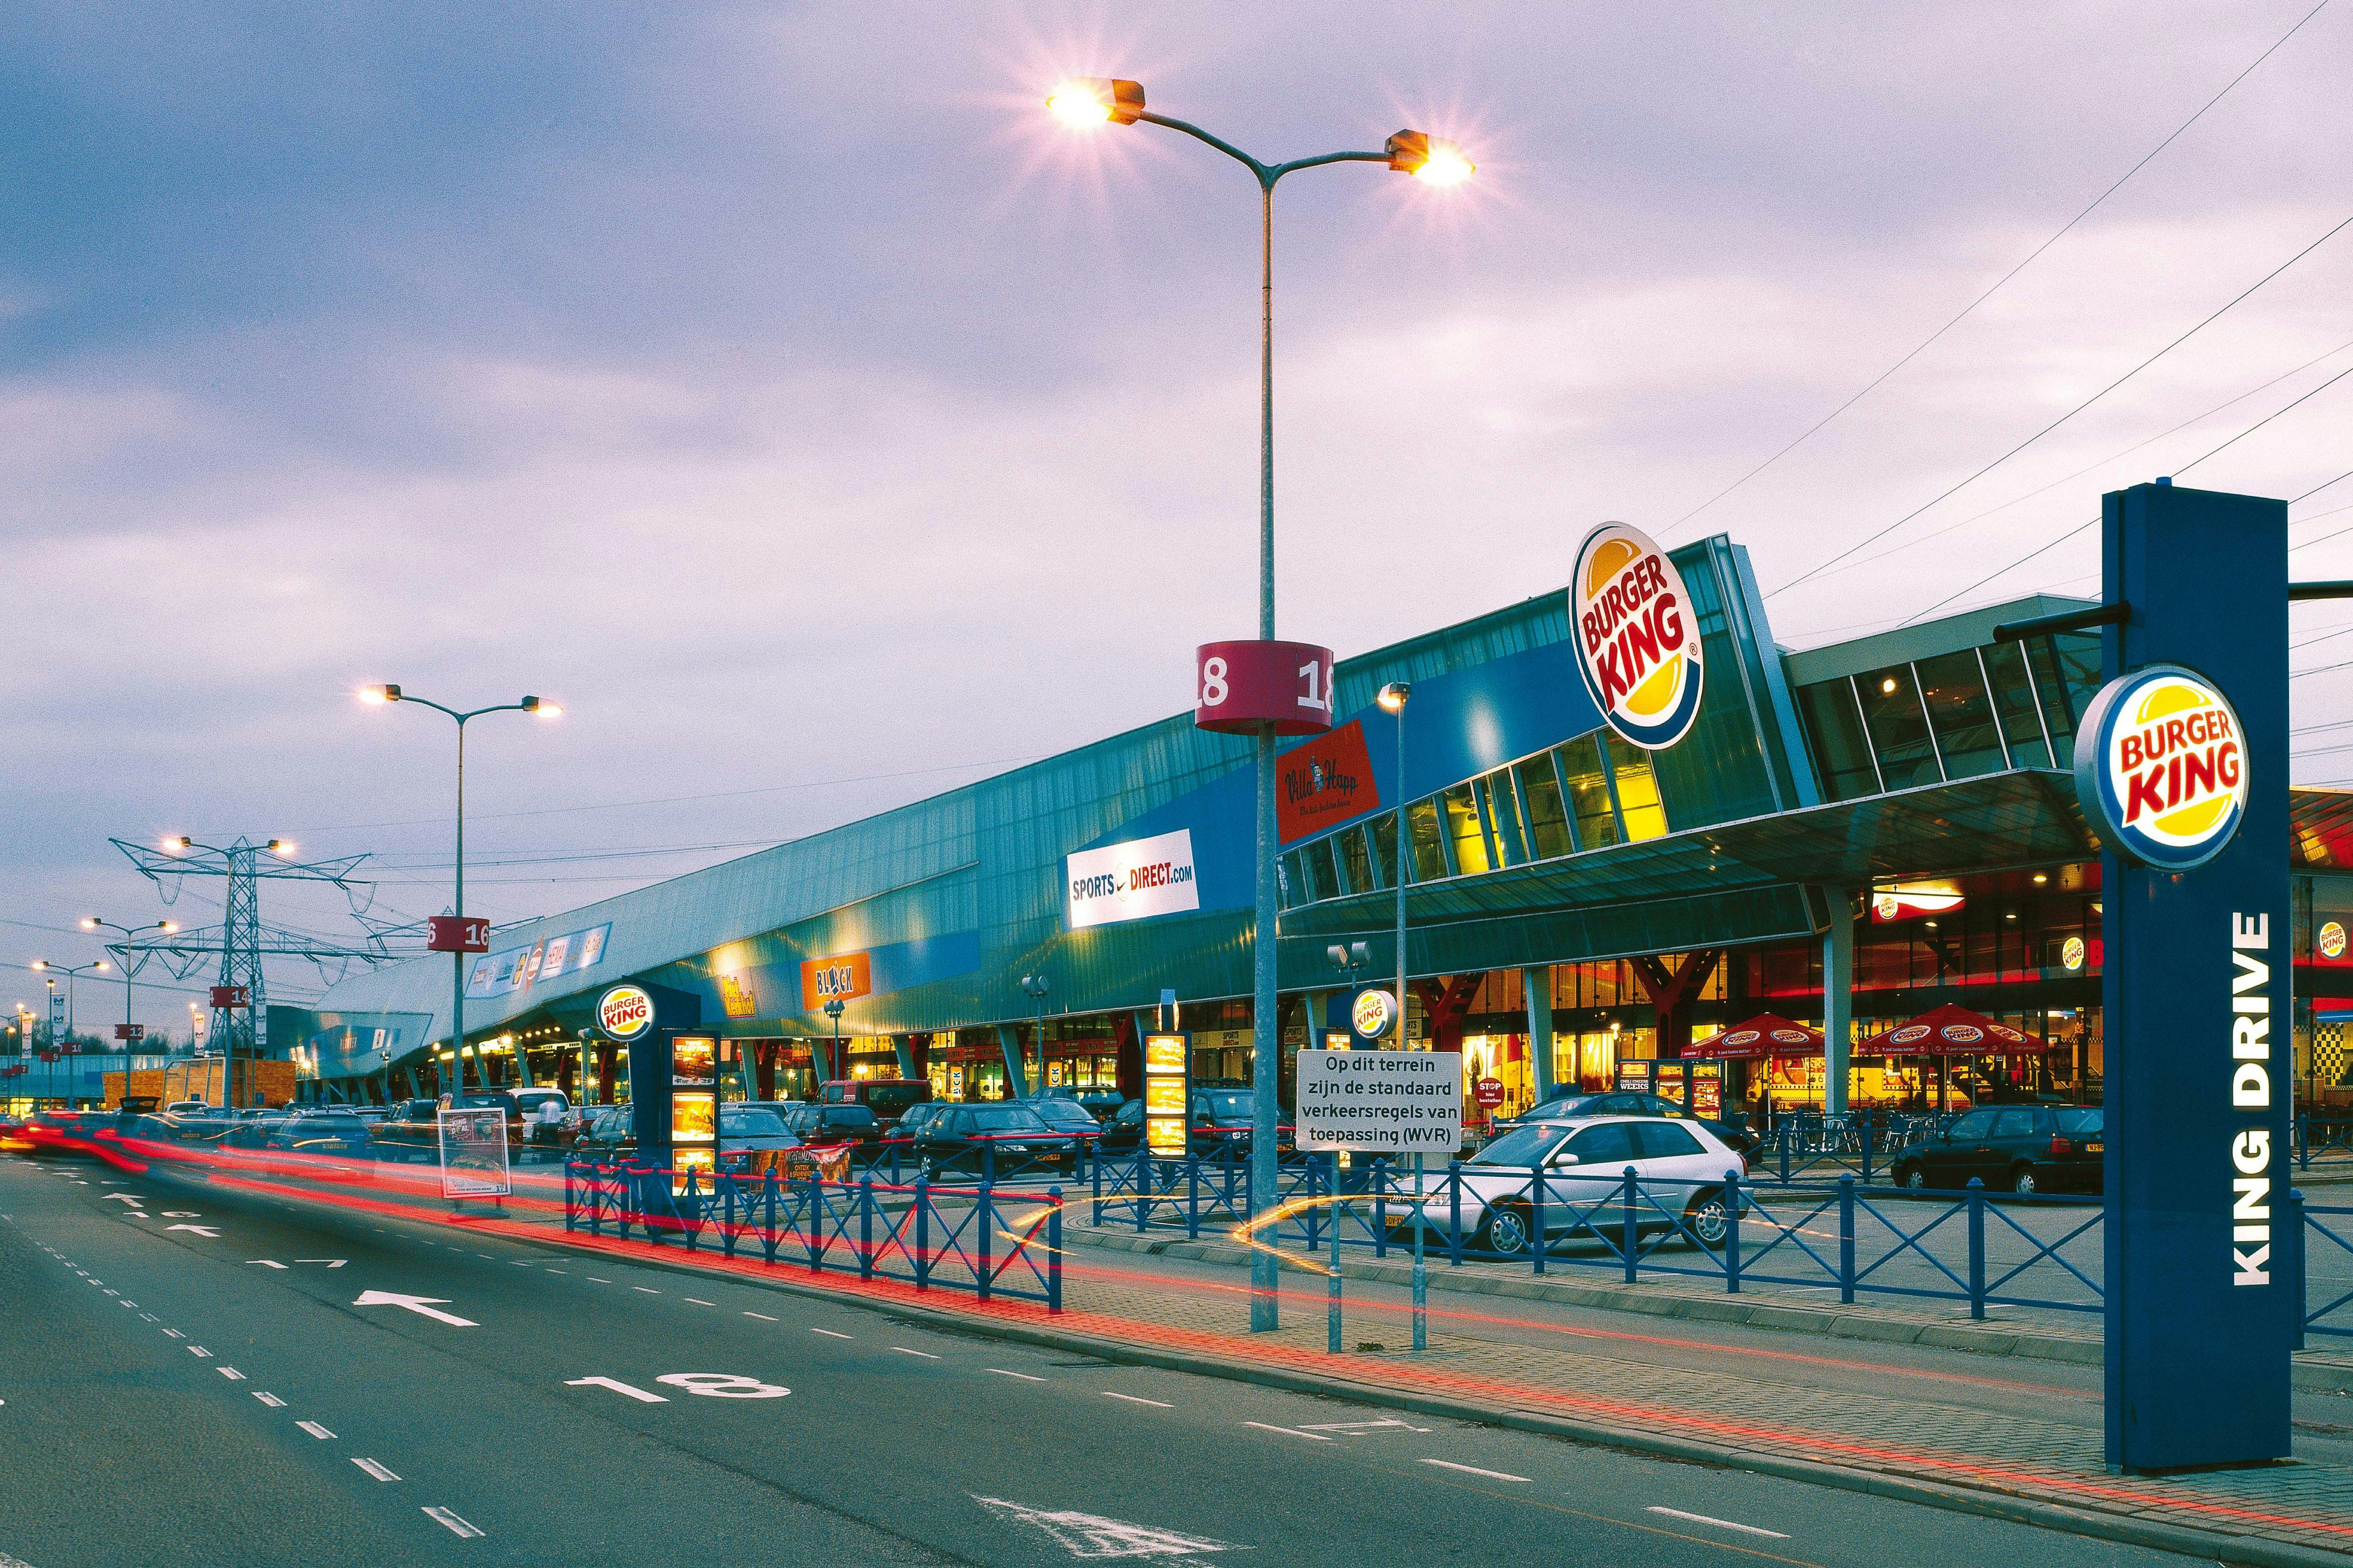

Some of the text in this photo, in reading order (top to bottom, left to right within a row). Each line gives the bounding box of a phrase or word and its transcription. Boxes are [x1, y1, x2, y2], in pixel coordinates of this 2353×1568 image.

[1583, 554, 1667, 658] BURGER
[1597, 593, 1683, 713] KING
[2120, 710, 2232, 773] BURGER
[1285, 758, 1358, 805] Villa Happ
[2125, 741, 2239, 824] KING
[1073, 862, 1192, 901] SPORTS DIRECT.COM
[1882, 905, 1895, 913] KING
[465, 924, 489, 946] 16
[2322, 929, 2342, 942] BURGER
[2322, 935, 2343, 951] KING
[2064, 942, 2080, 958] BURGER
[2065, 948, 2082, 966] KING
[232, 990, 247, 1003] 14
[604, 996, 644, 1015] BURGER
[1356, 999, 1381, 1016] BURGER
[1358, 1006, 1382, 1027] KING
[606, 1005, 646, 1029] KING
[130, 1027, 143, 1037] 12
[1223, 1030, 1239, 1040] SPORTS
[1326, 1056, 1435, 1073] Op dit terrein
[1309, 1081, 1451, 1098] zijn de standaard
[2232, 912, 2269, 1286] KING DRIVE
[1302, 1104, 1457, 1122] verkeersregels van
[1310, 1128, 1451, 1146] toepassing (WVR)
[245, 1260, 348, 1269] 17
[563, 1373, 792, 1402] 18
